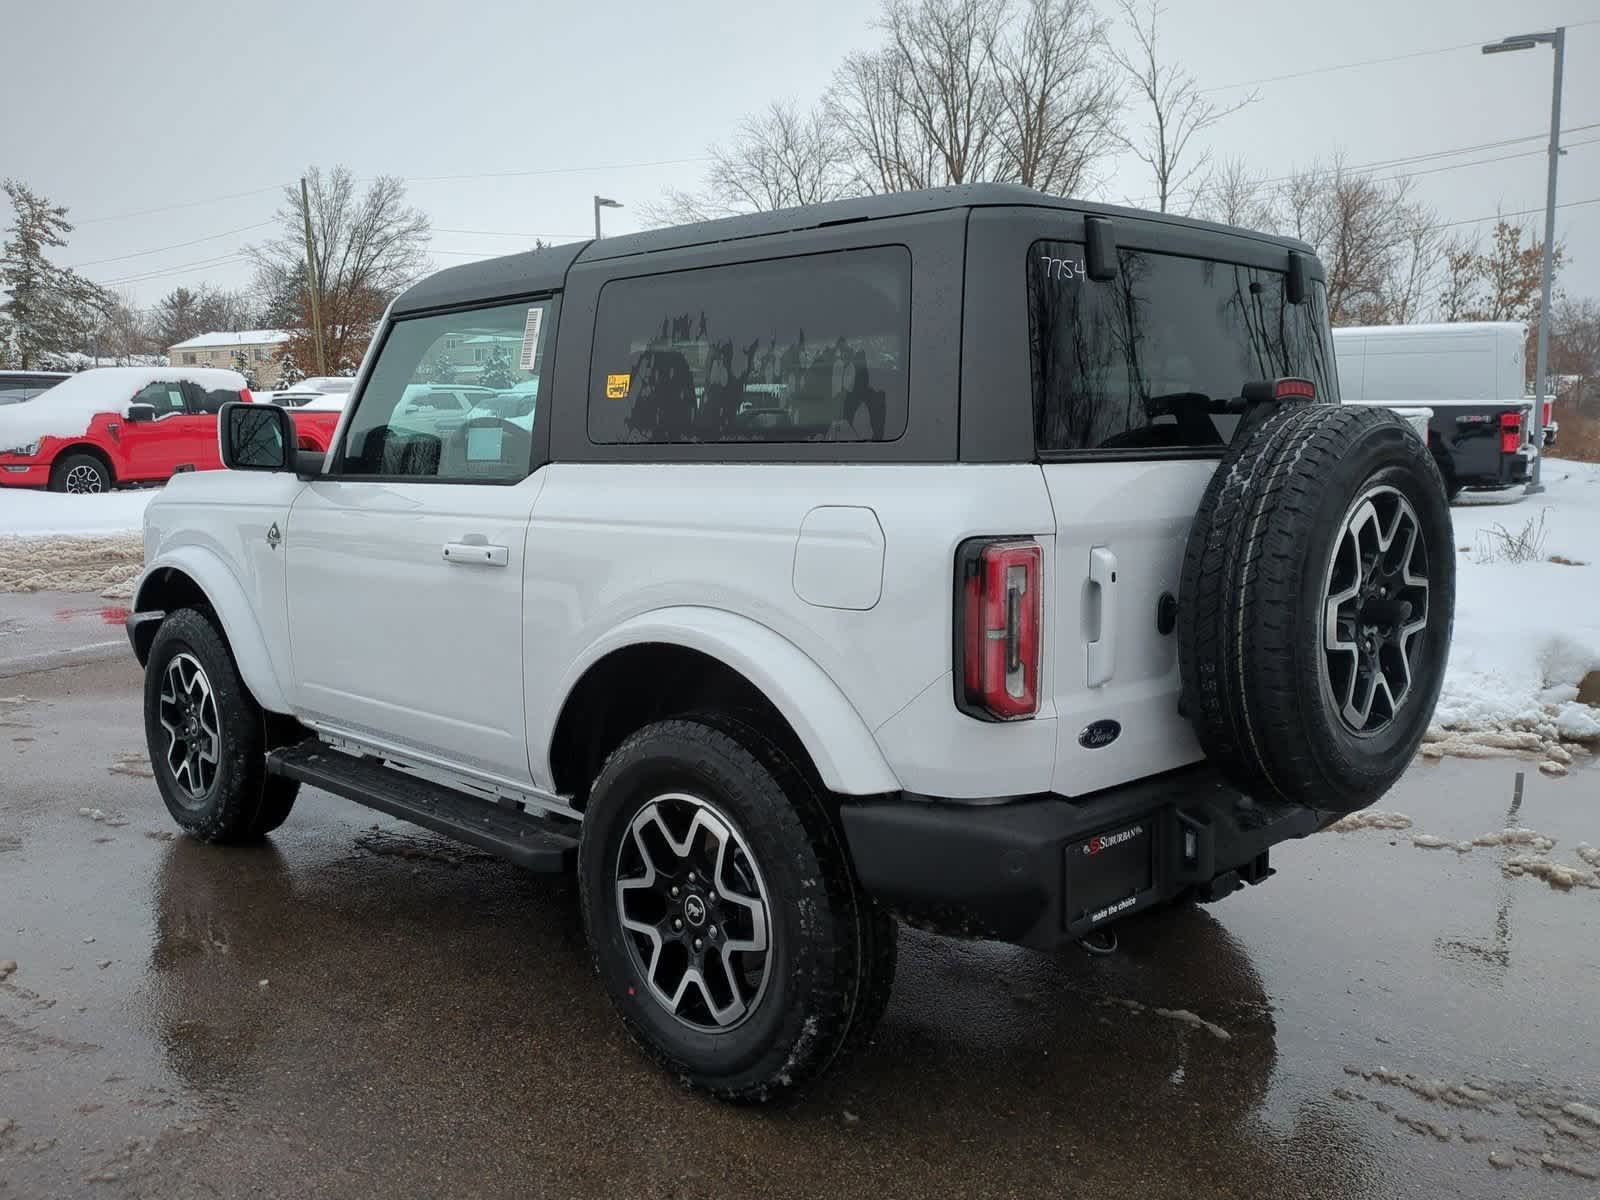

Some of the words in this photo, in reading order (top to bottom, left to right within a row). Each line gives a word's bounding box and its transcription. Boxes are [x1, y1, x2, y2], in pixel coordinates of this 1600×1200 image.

[1040, 256, 1086, 282] 7754
[1108, 904, 1118, 915] the
[1118, 897, 1136, 911] choice
